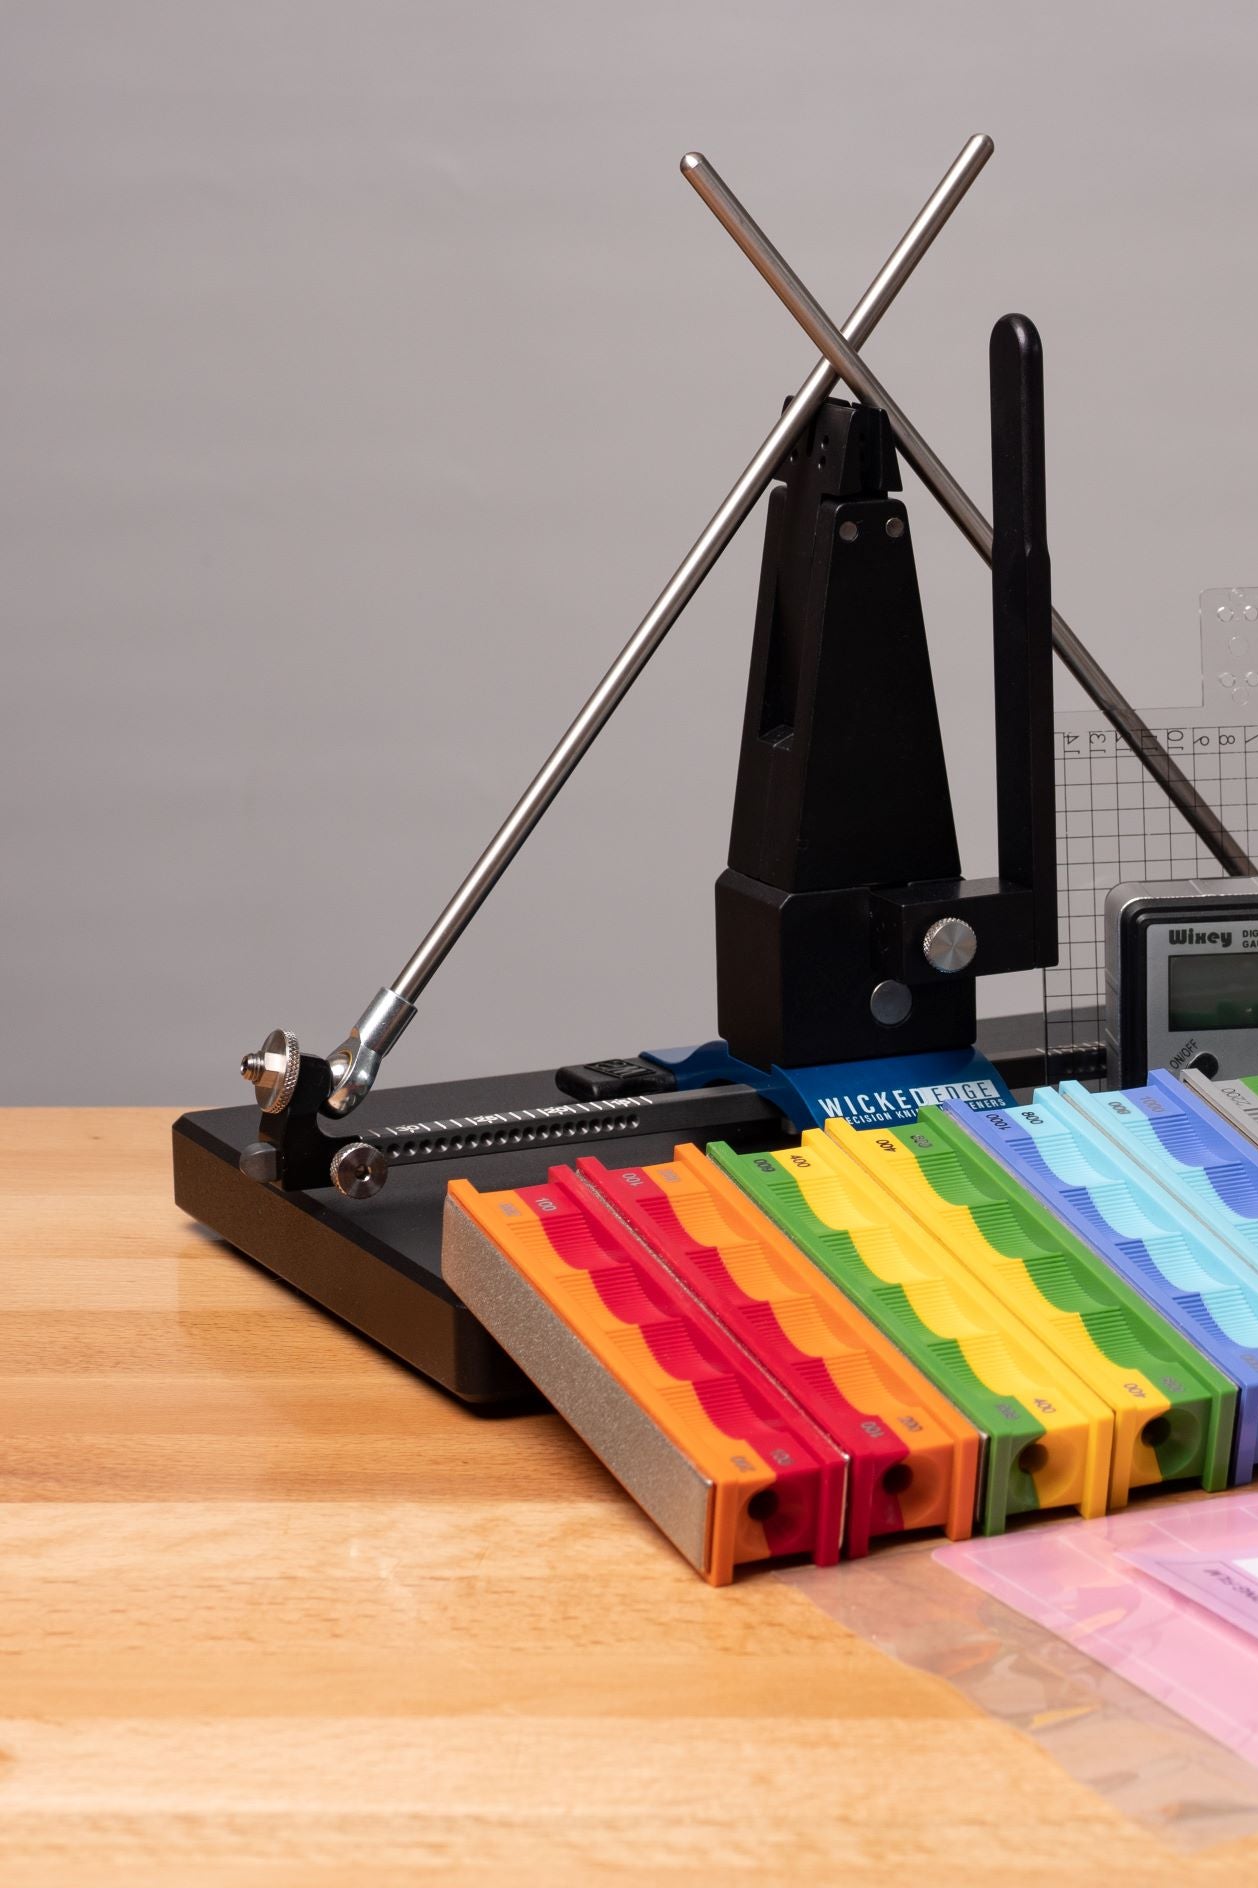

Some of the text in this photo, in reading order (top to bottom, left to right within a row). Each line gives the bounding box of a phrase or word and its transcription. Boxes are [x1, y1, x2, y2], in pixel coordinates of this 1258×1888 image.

[1168, 928, 1232, 948] Wixey
[1169, 1038, 1198, 1069] ON/OFF
[845, 1112, 892, 1125] ECISION
[1021, 1110, 1045, 1125] 800
[789, 1154, 812, 1168] 400
[536, 1197, 557, 1212] 100
